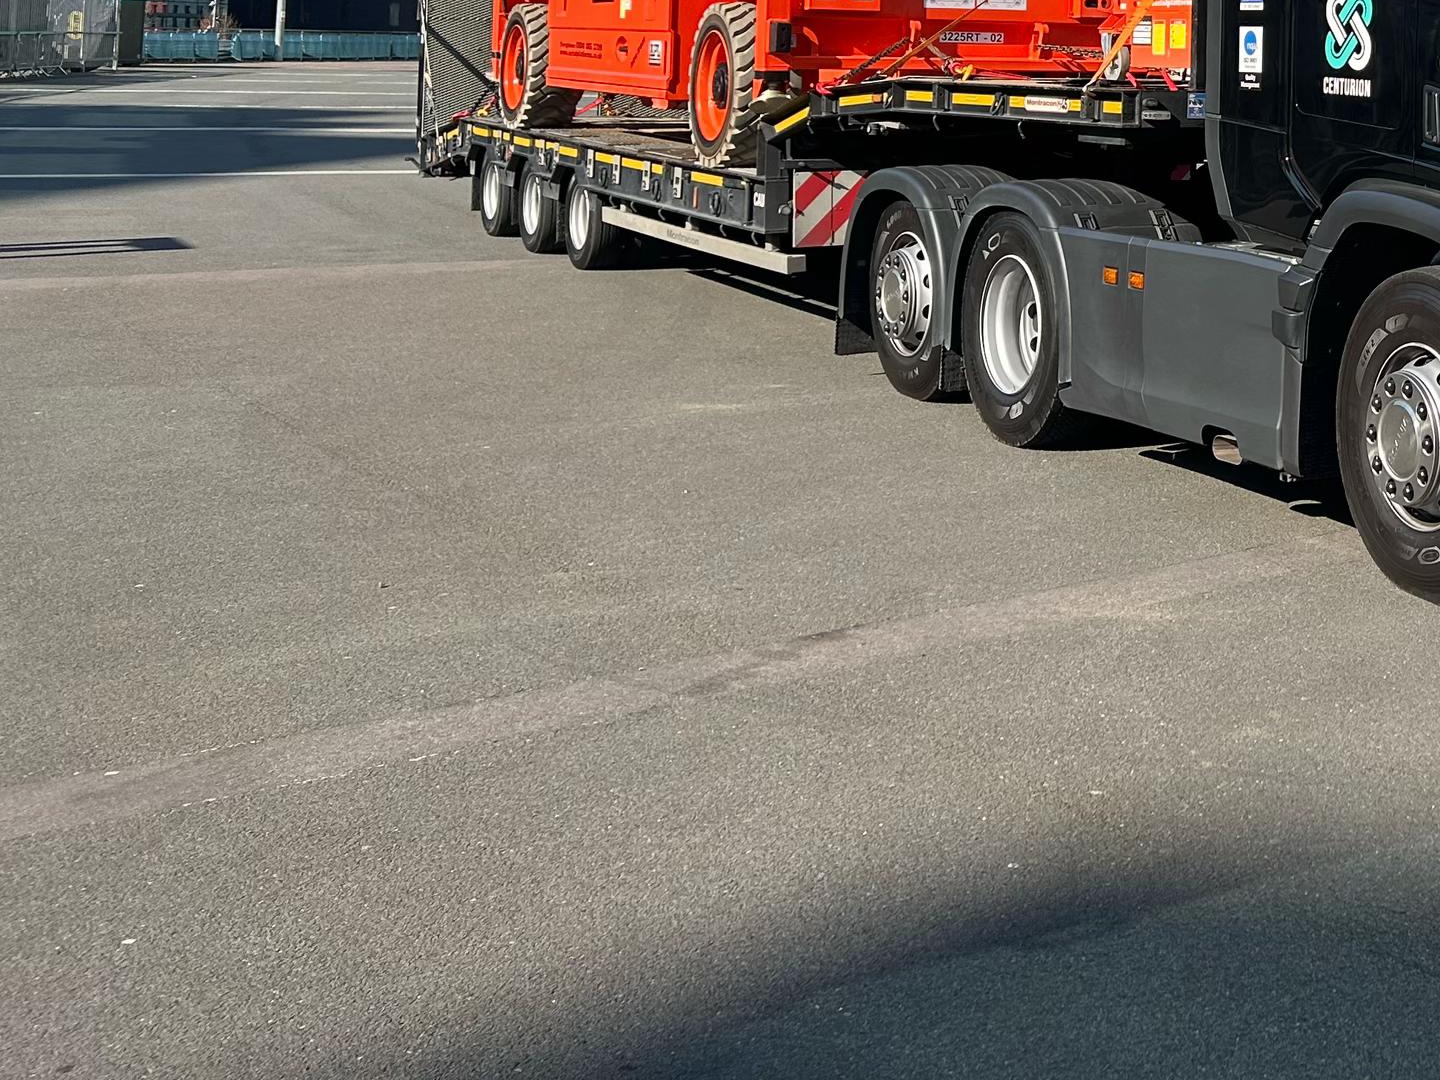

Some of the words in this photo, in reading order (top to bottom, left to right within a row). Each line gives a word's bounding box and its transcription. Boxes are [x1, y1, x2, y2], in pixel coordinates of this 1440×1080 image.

[941, 32, 981, 42] 3225RT
[990, 33, 1003, 42] 02
[1323, 76, 1371, 98] CENTURION
